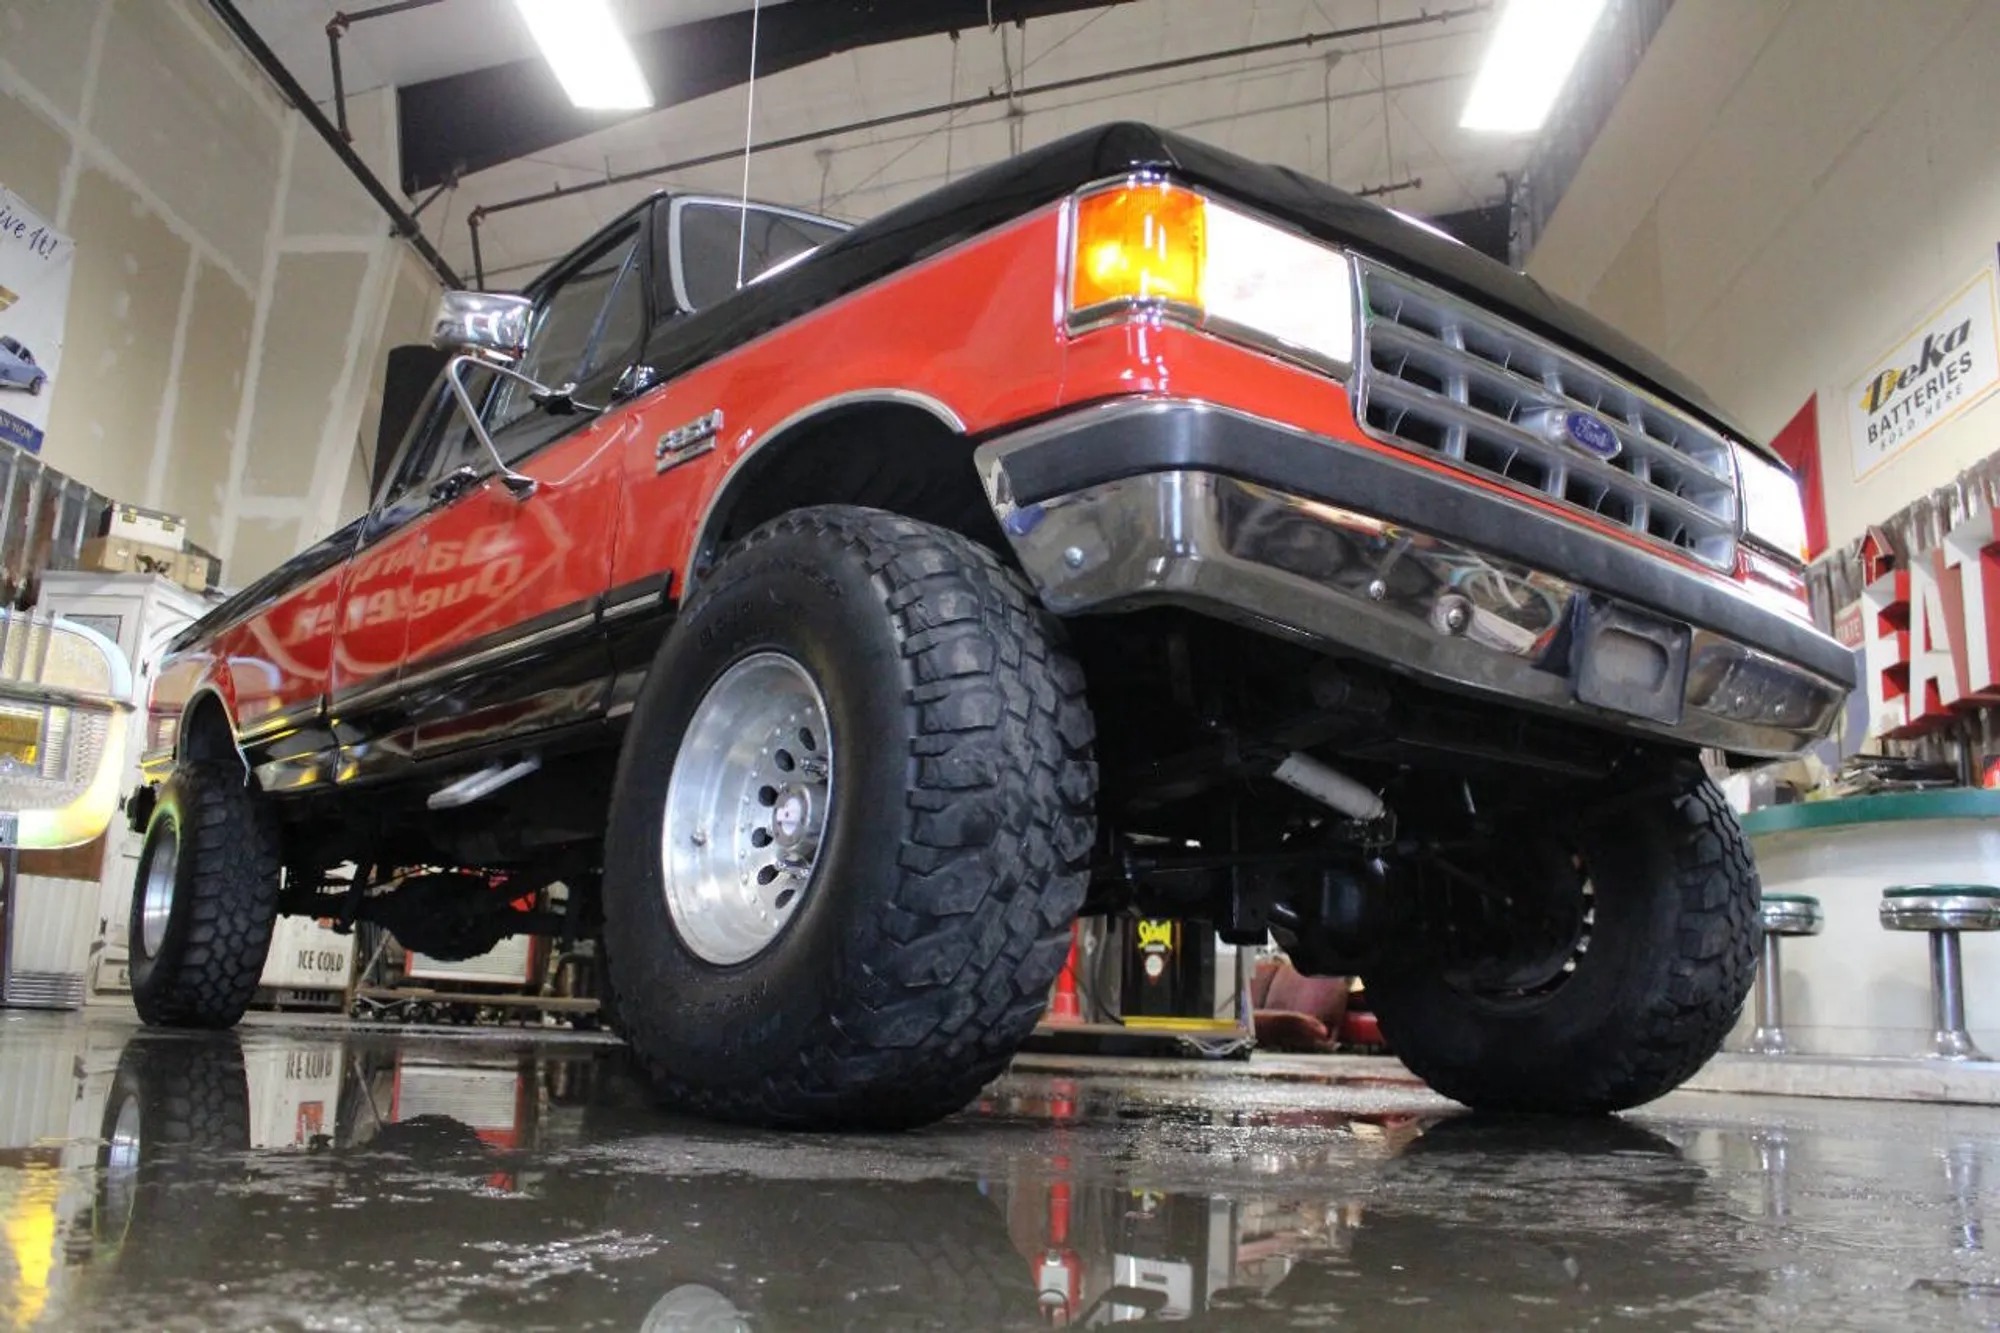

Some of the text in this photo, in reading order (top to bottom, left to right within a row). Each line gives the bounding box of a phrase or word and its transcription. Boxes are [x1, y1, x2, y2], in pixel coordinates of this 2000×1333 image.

[1867, 351, 1973, 445] BATTERIES
[1869, 317, 1971, 415] Deka
[1572, 415, 1611, 450] Ford
[1861, 500, 2000, 738] EAT
[298, 950, 344, 972] ICE COLD
